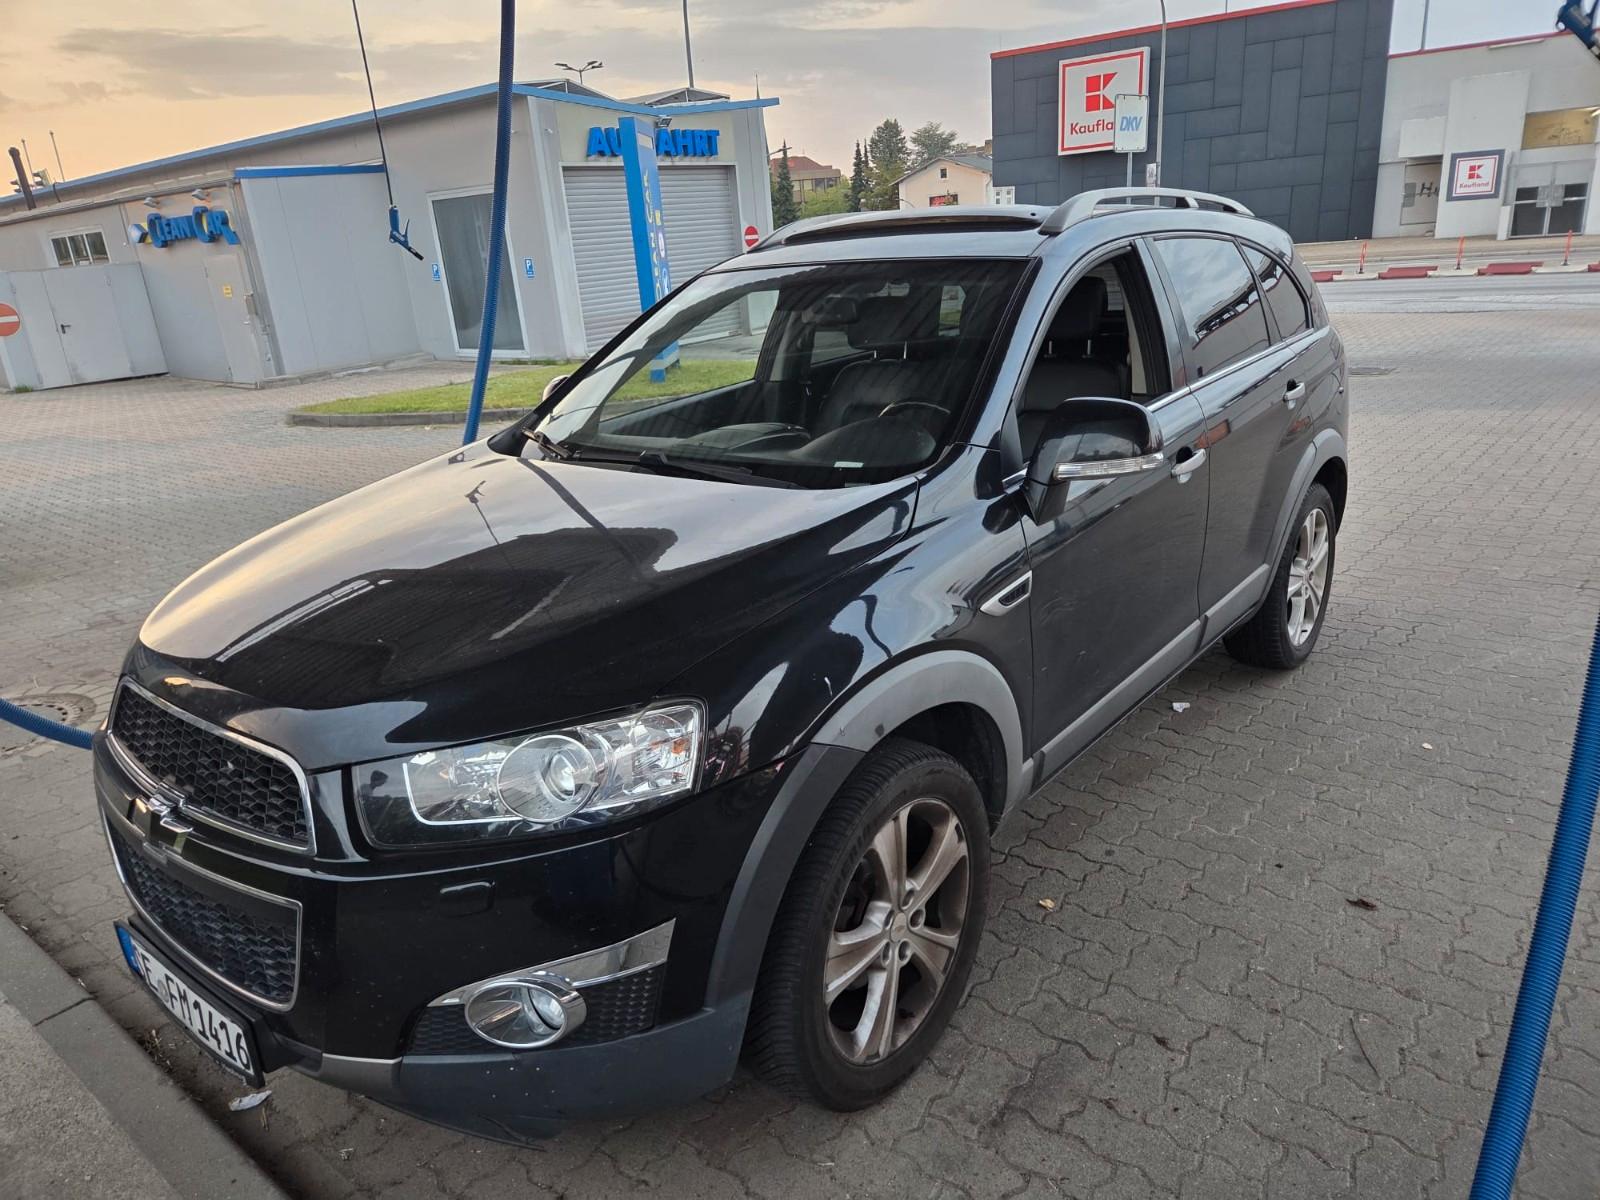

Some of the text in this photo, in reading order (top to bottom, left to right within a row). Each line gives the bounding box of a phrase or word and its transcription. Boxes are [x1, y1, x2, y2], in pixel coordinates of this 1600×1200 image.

[1070, 119, 1114, 135] Kaufla
[1120, 116, 1143, 131] DKV
[586, 127, 720, 157] AUAHRT
[1459, 181, 1490, 190] Kaufland
[147, 206, 240, 248] CLEAN CAR
